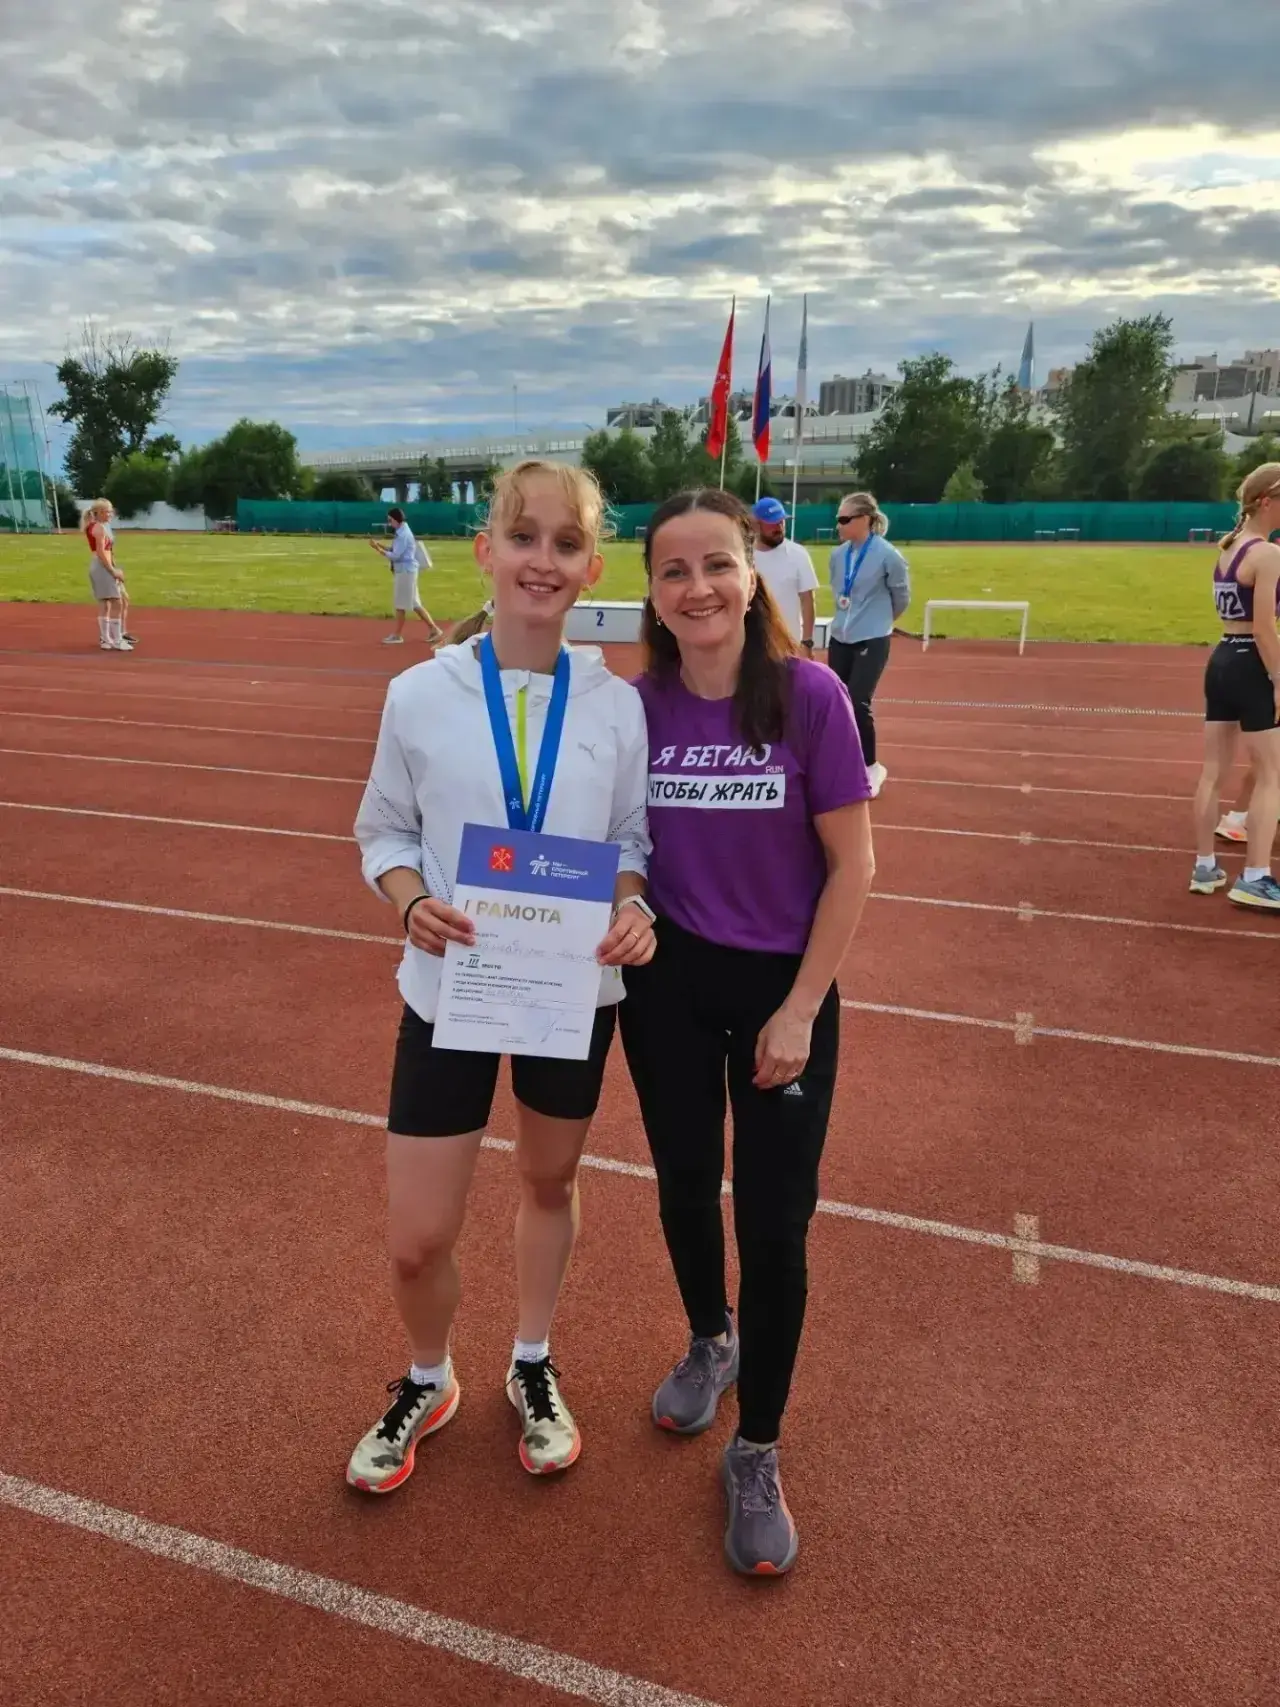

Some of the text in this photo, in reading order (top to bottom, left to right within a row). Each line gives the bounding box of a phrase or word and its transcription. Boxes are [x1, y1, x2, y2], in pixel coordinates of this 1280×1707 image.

[596, 610, 604, 627] 2
[652, 743, 772, 767] Я БЕГАЮ
[765, 765, 784, 774] RUN
[649, 780, 778, 802] ЧТОБЫ ЖРАТЬ
